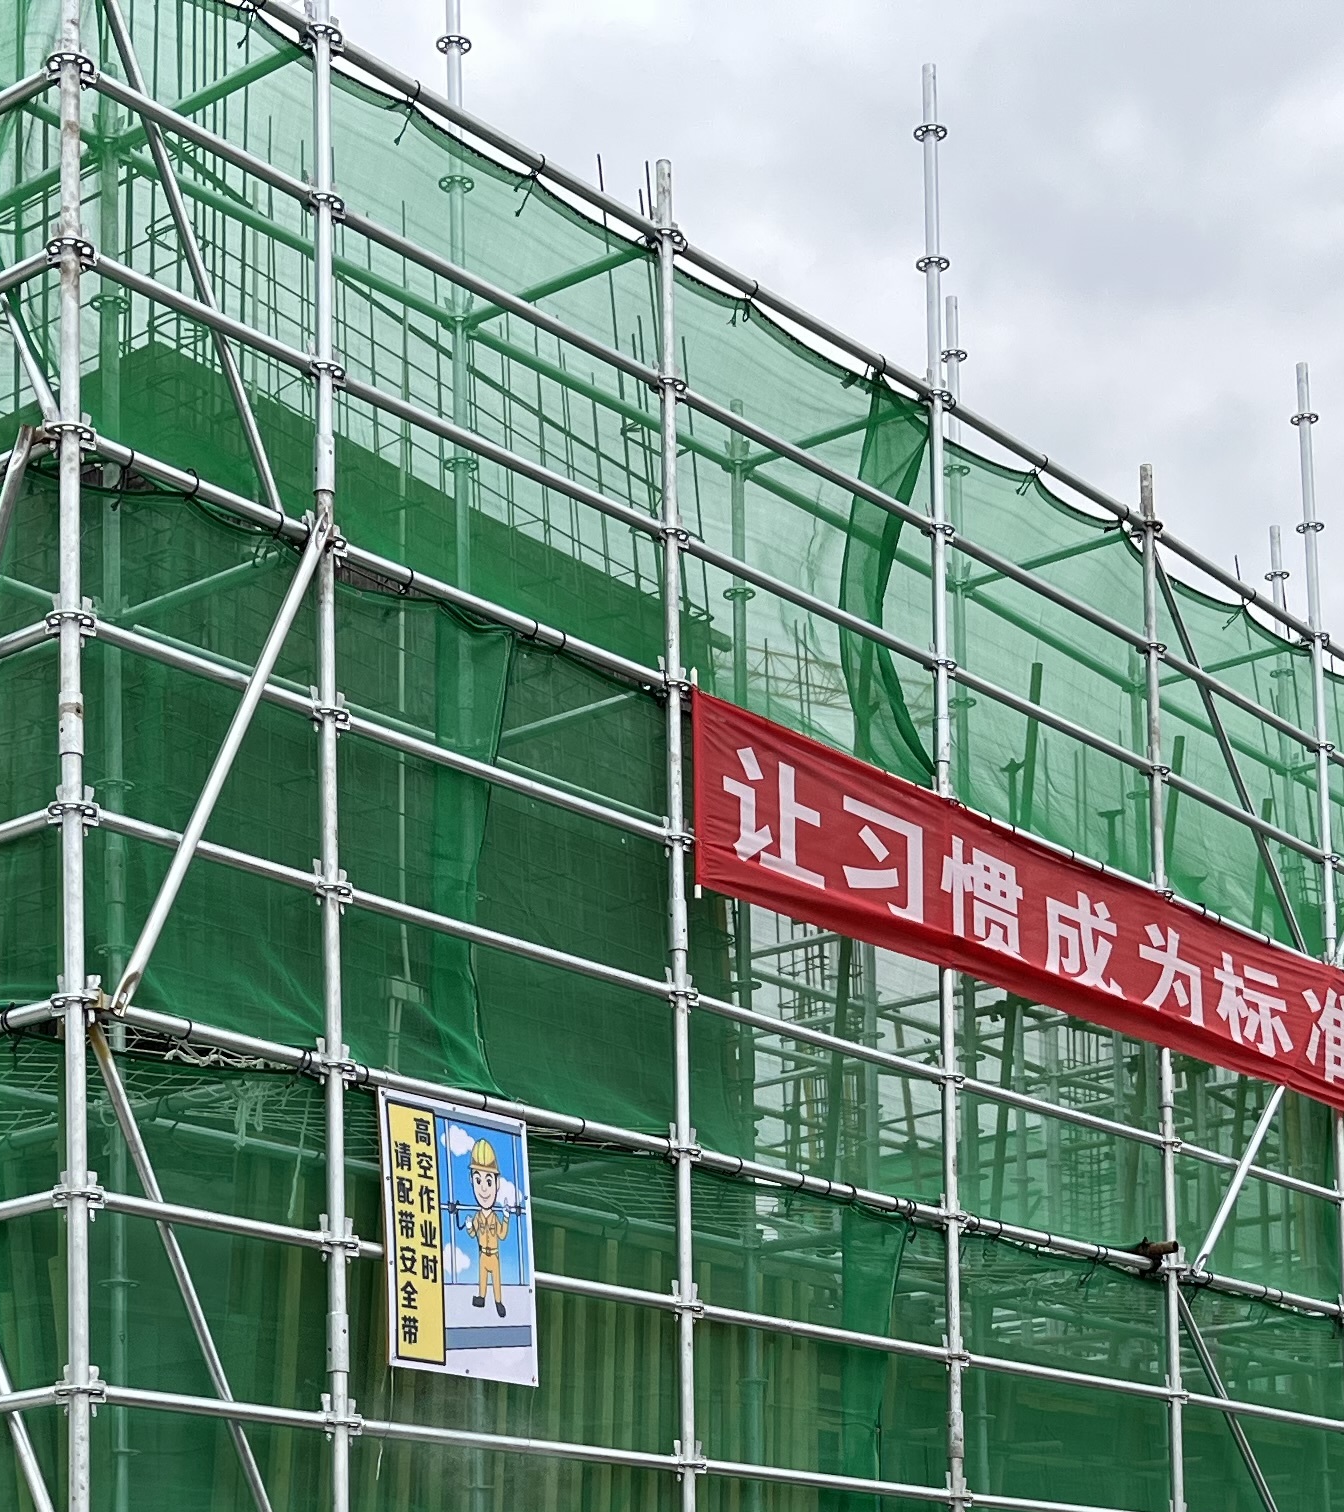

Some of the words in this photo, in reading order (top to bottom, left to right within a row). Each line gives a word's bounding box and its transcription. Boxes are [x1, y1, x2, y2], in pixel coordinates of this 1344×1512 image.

[394, 1140, 419, 1346] 请配带安全带
[413, 1117, 438, 1284] 高空作业时
